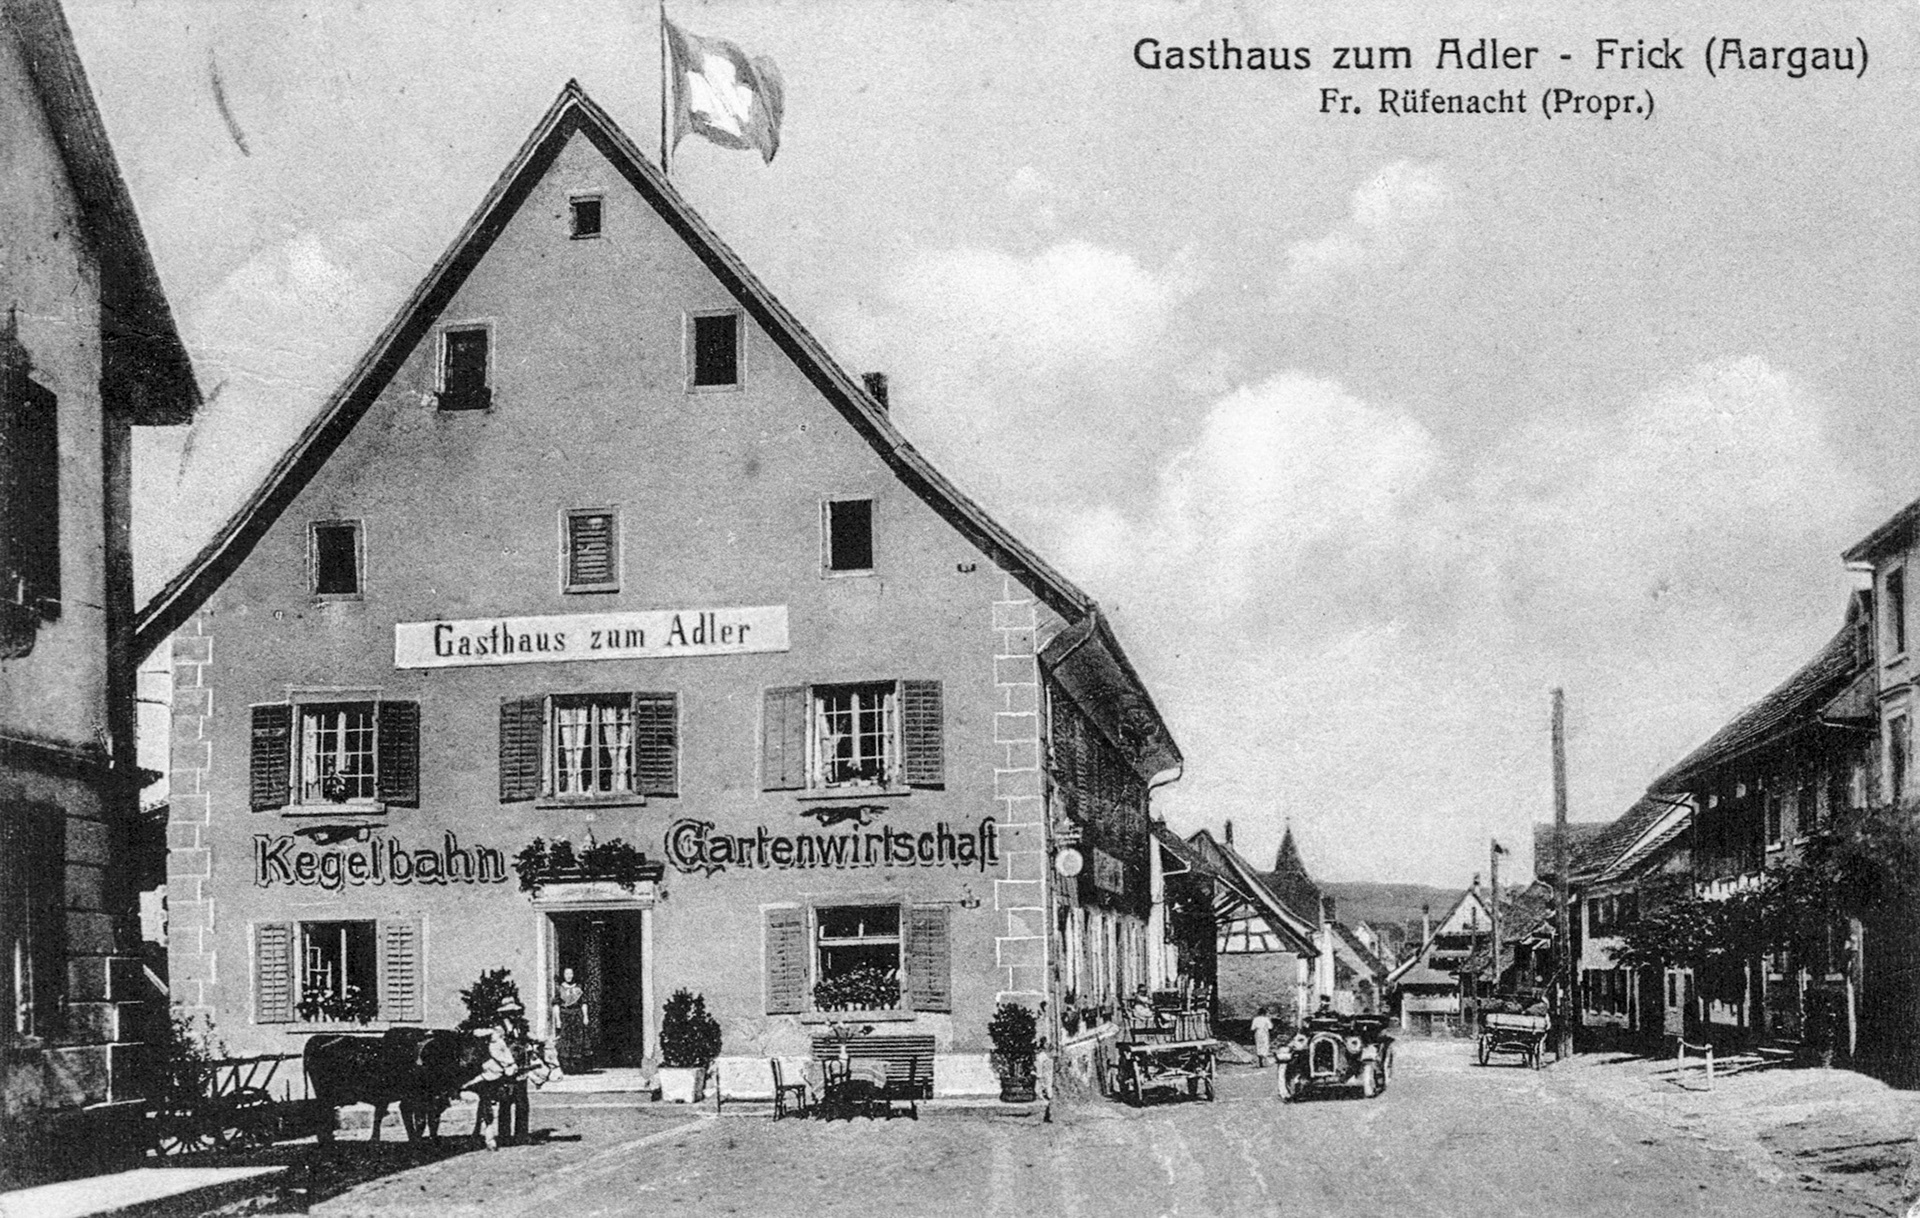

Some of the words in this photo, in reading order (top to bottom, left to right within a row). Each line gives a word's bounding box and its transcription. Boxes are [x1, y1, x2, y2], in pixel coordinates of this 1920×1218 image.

[433, 613, 566, 657] Gasthaus
[590, 627, 645, 650] zum
[666, 611, 752, 648] Adler
[253, 830, 508, 892] Kegelbahn
[664, 817, 1000, 878] Gartenwirtschaft
